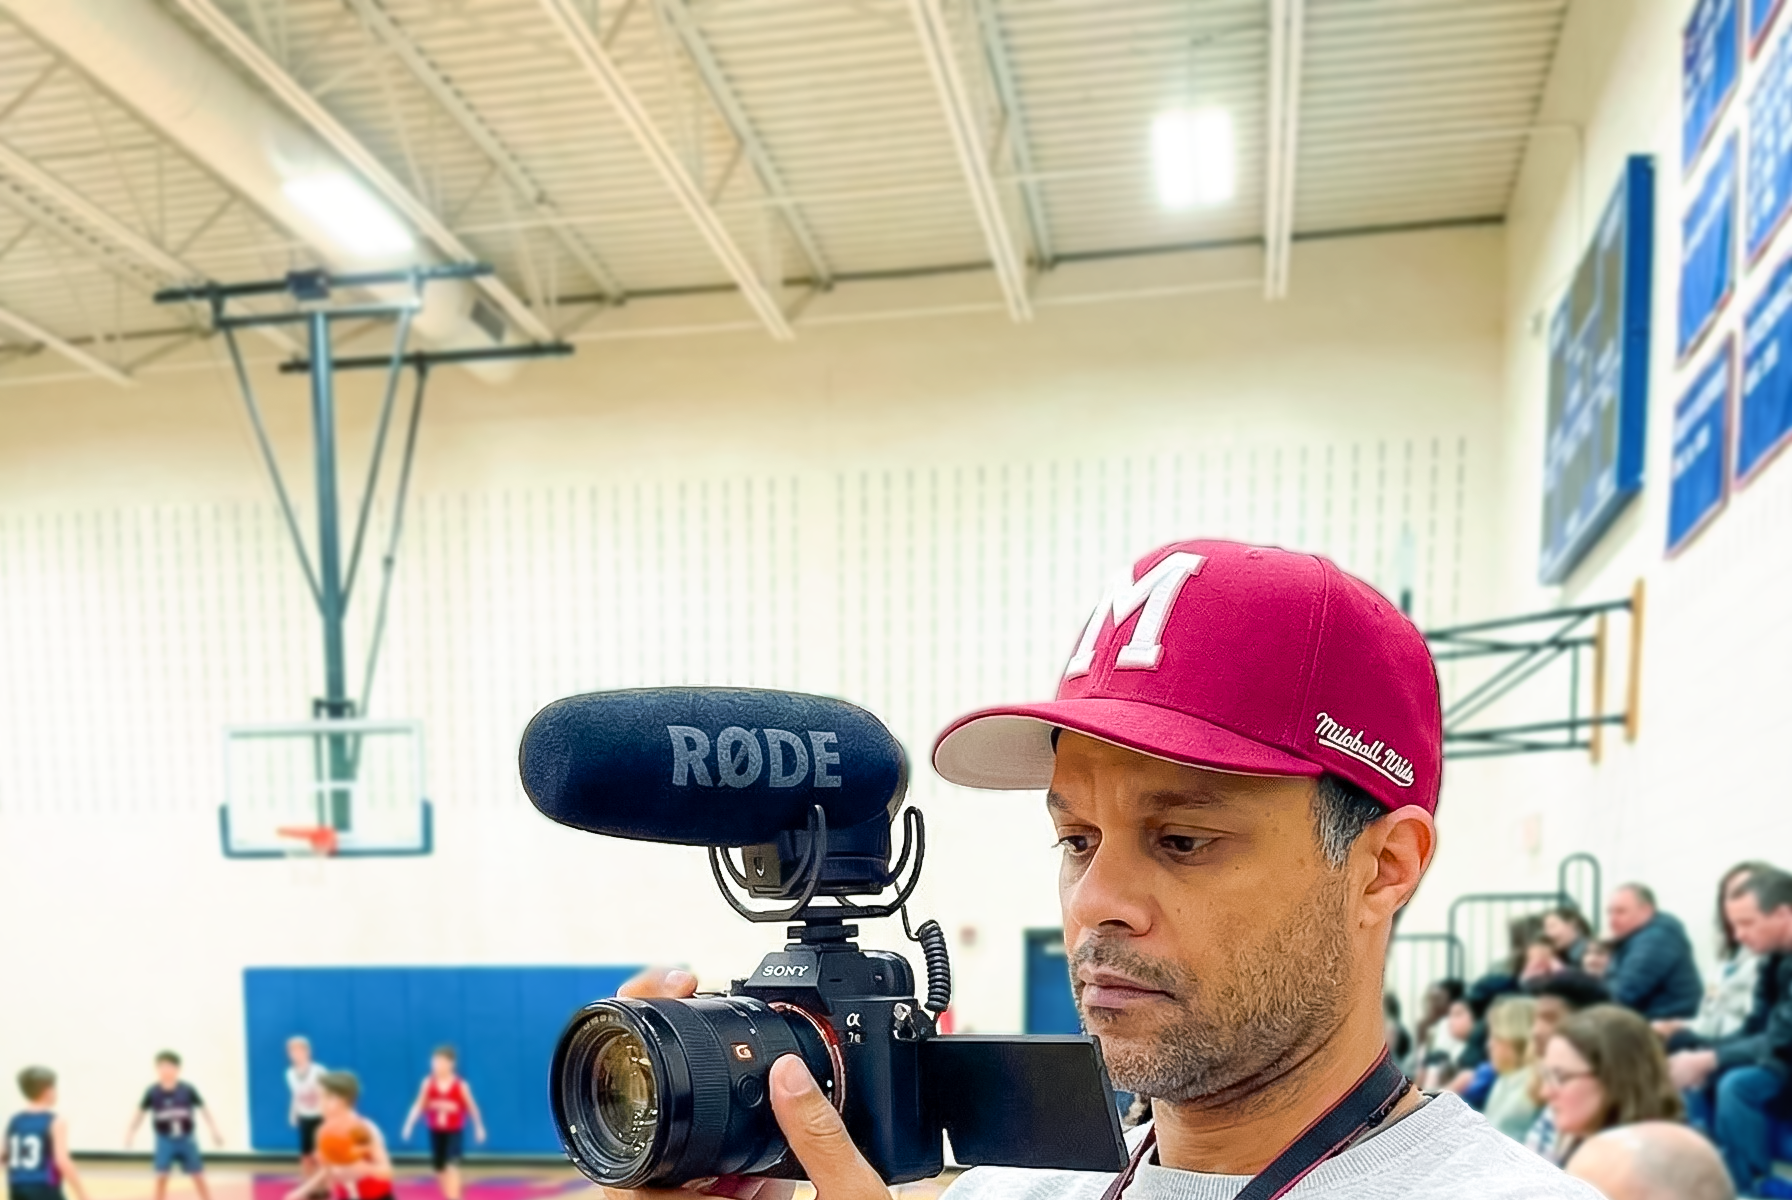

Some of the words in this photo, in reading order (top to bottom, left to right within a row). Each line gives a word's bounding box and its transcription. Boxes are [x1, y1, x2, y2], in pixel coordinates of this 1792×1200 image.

[1066, 551, 1208, 681] M
[666, 724, 843, 789] RØDE
[762, 965, 809, 977] SONY
[9, 1134, 41, 1169] 13
